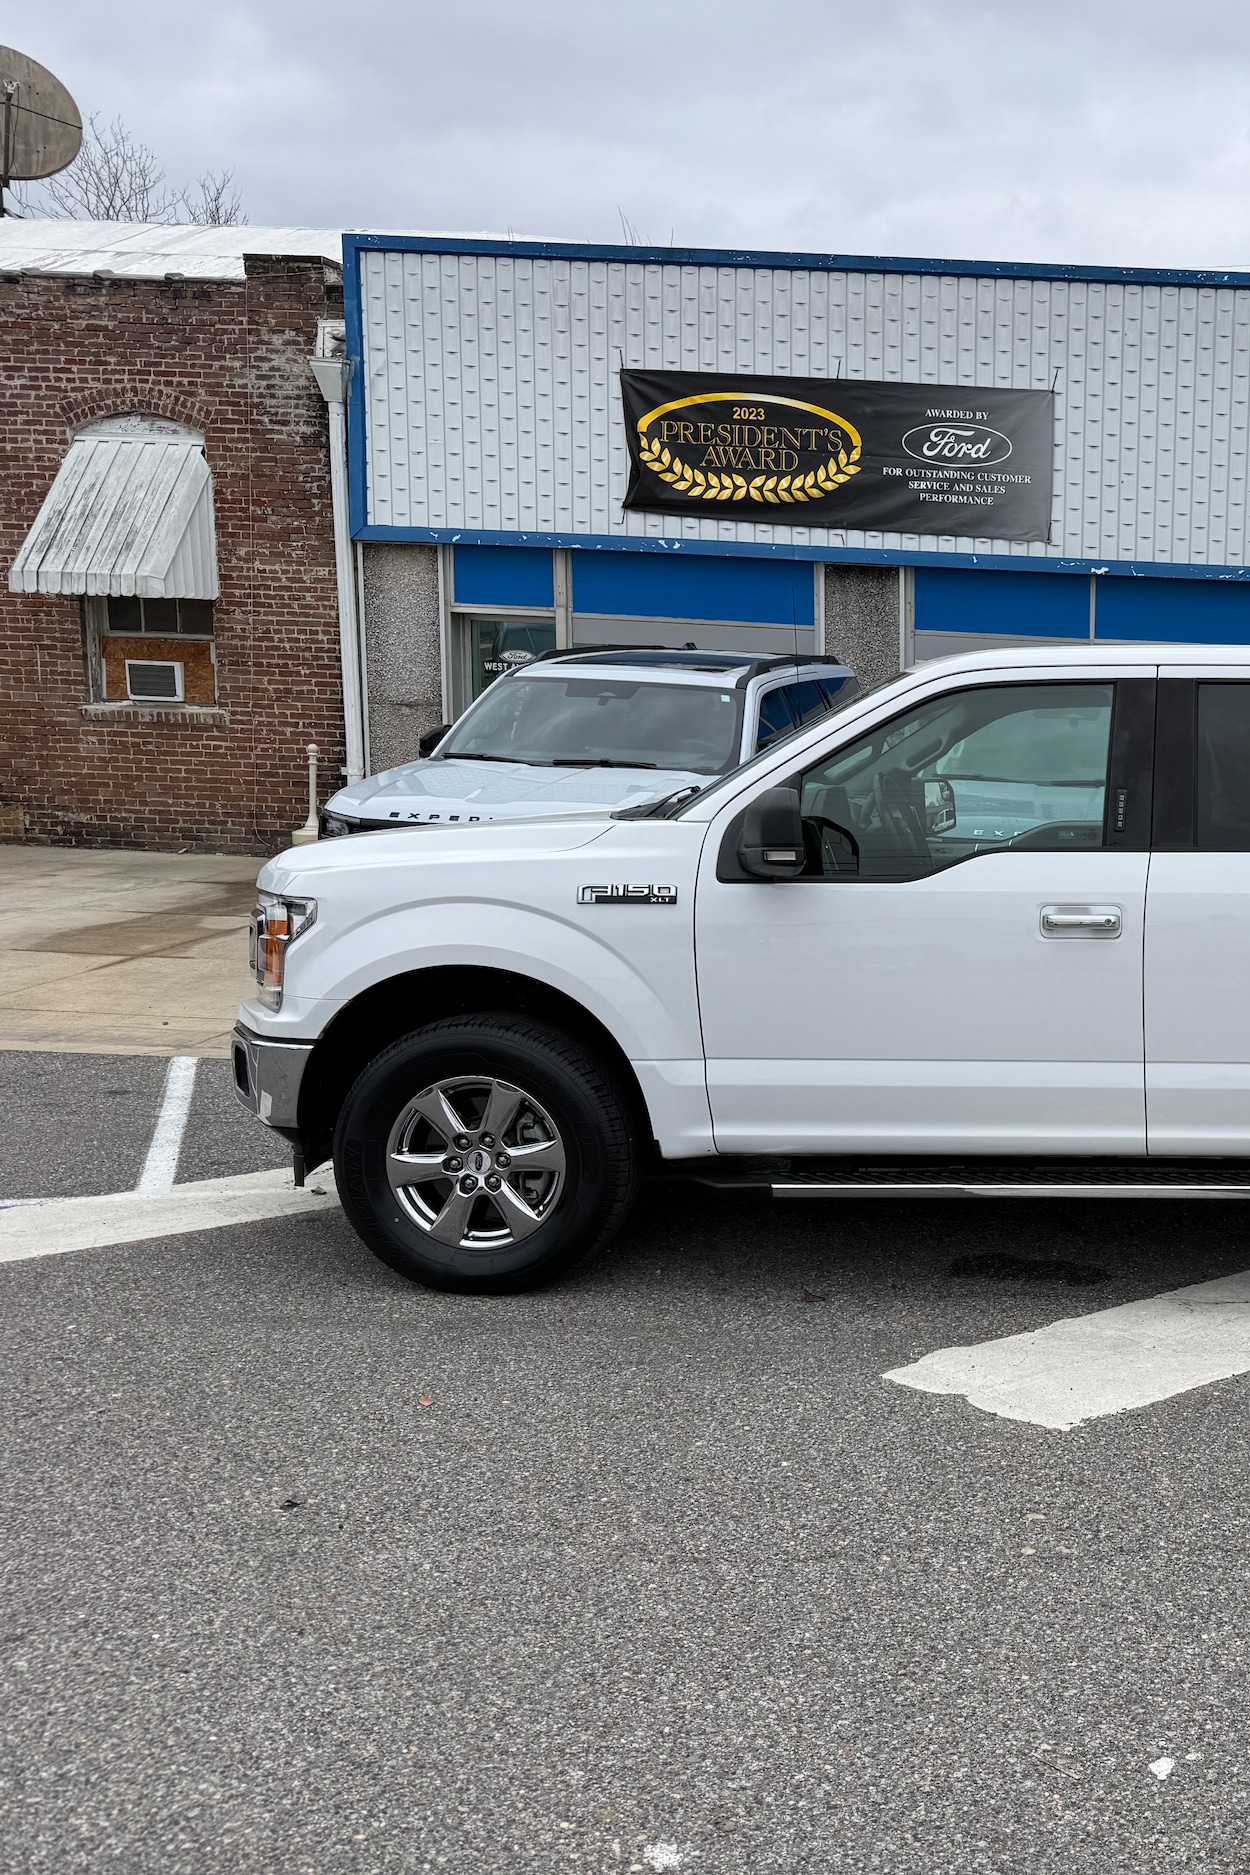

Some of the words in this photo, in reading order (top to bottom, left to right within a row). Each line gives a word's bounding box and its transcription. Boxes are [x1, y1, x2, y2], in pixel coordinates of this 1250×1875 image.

[732, 407, 766, 421] 2023
[925, 409, 973, 419] AWARDED
[975, 411, 990, 420] BY
[660, 421, 843, 451] PRESIDENT'S
[922, 427, 992, 459] Ford
[700, 446, 799, 472] AWARD
[882, 466, 903, 477] FOR
[905, 468, 975, 480] OUTSTANDING
[977, 472, 1032, 484] CUSTOMER
[908, 481, 950, 491] SERVICE
[953, 483, 973, 492] AND
[975, 485, 1006, 494] SALES
[919, 493, 994, 505] PERFORMANCE
[484, 662, 508, 671] WEST
[389, 811, 494, 822] EXPED
